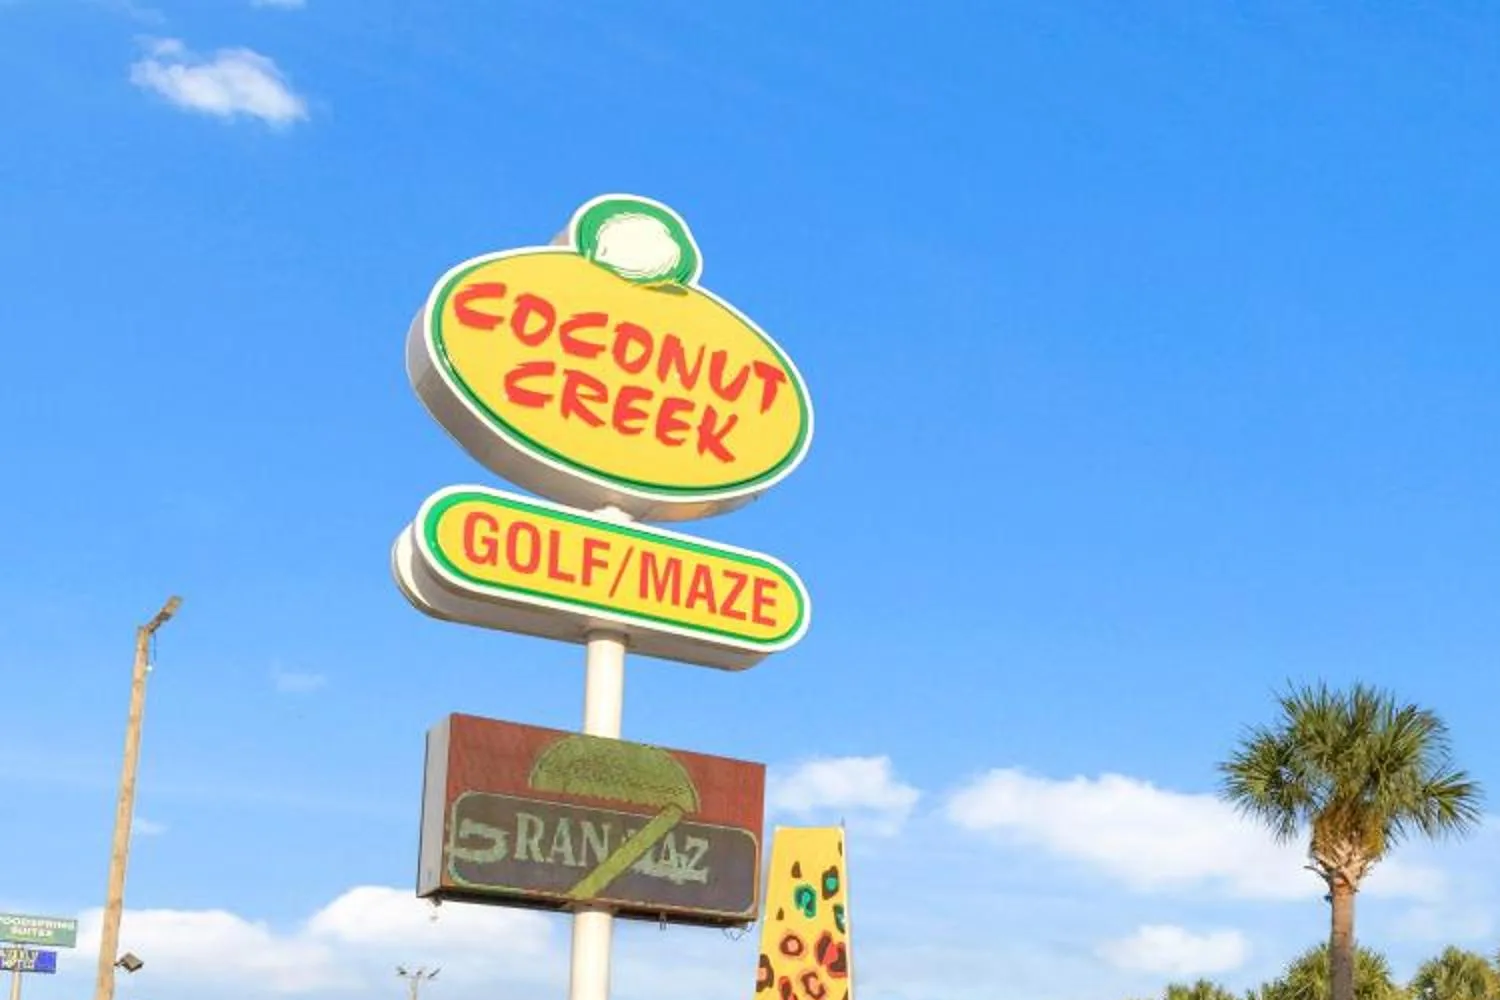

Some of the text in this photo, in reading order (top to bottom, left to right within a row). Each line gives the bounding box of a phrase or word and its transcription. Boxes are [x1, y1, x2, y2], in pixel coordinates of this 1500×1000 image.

[453, 282, 787, 414] COCONUT
[504, 362, 740, 464] CREEK
[462, 511, 777, 628] GOLF/MAZE
